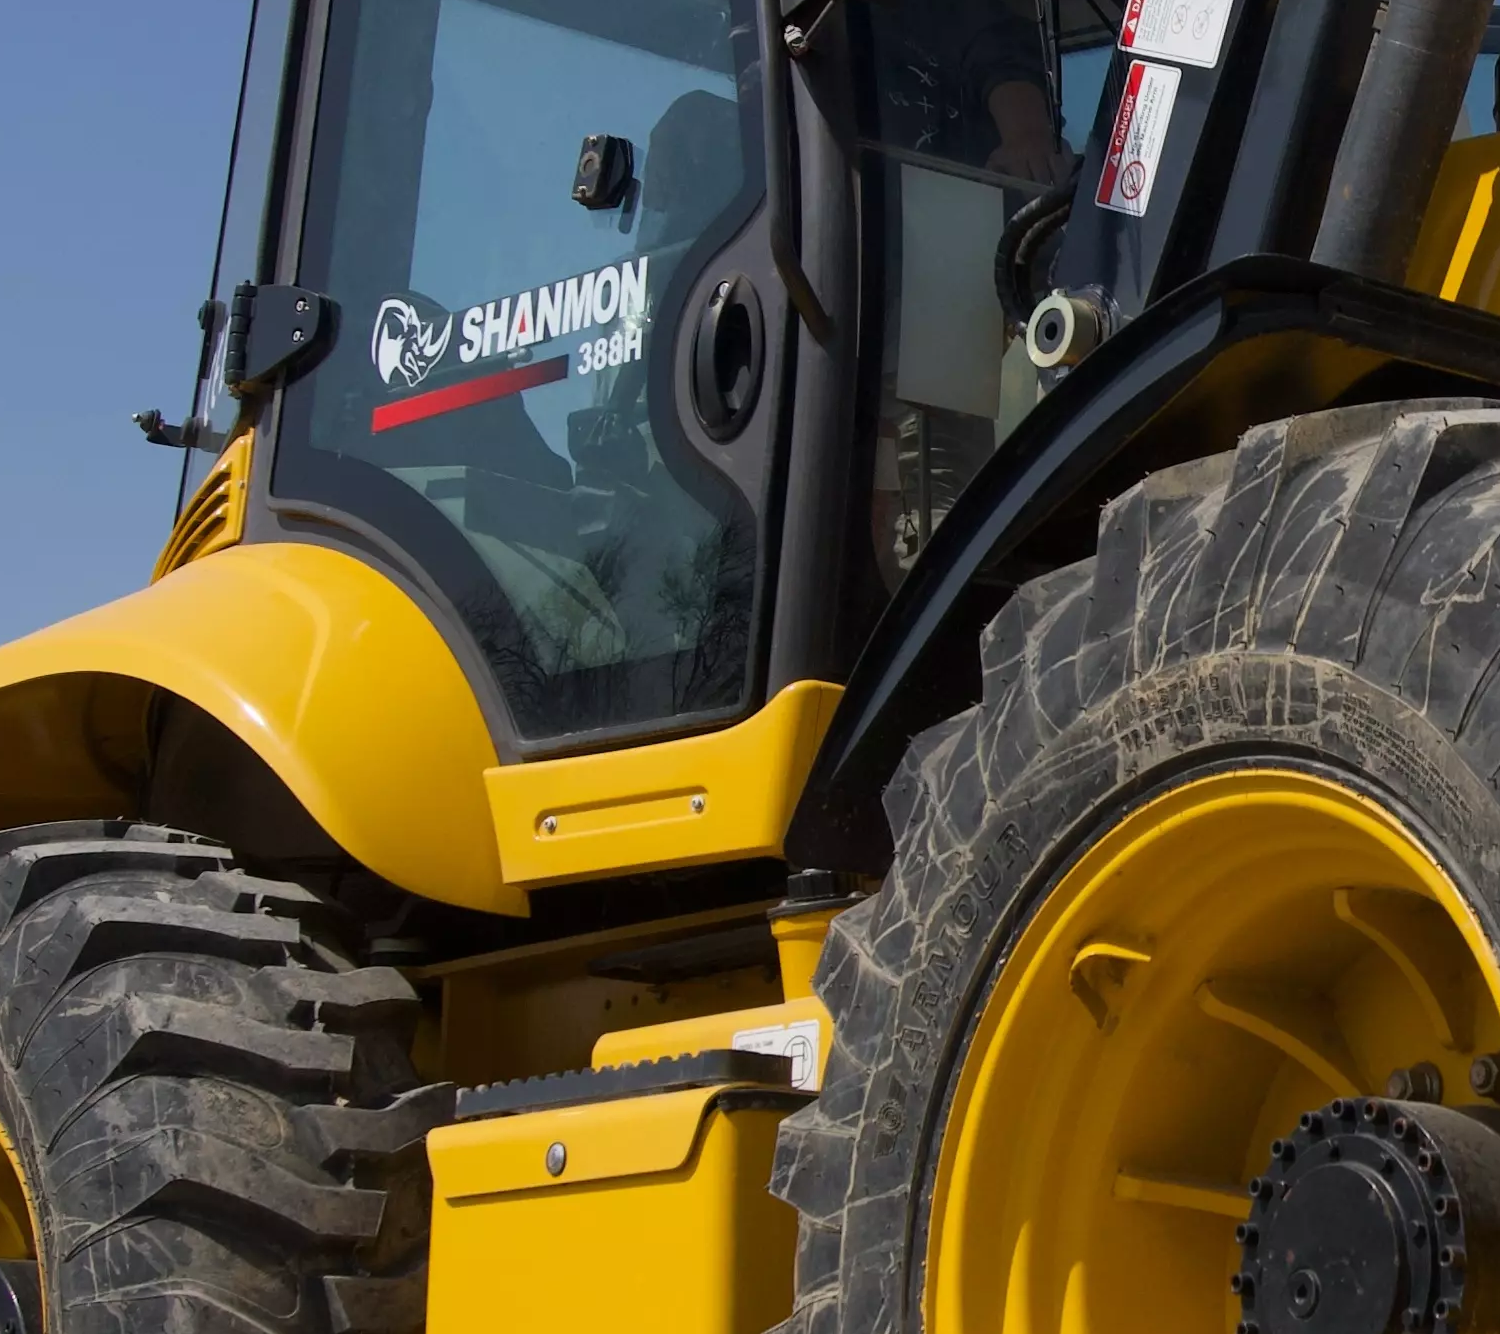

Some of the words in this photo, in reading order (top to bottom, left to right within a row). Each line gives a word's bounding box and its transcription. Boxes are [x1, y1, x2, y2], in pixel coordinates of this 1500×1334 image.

[1115, 94, 1135, 146] DANGER
[459, 256, 649, 364] SHANMON
[577, 328, 642, 375] 388H
[900, 822, 1034, 1072] ARMOUR
